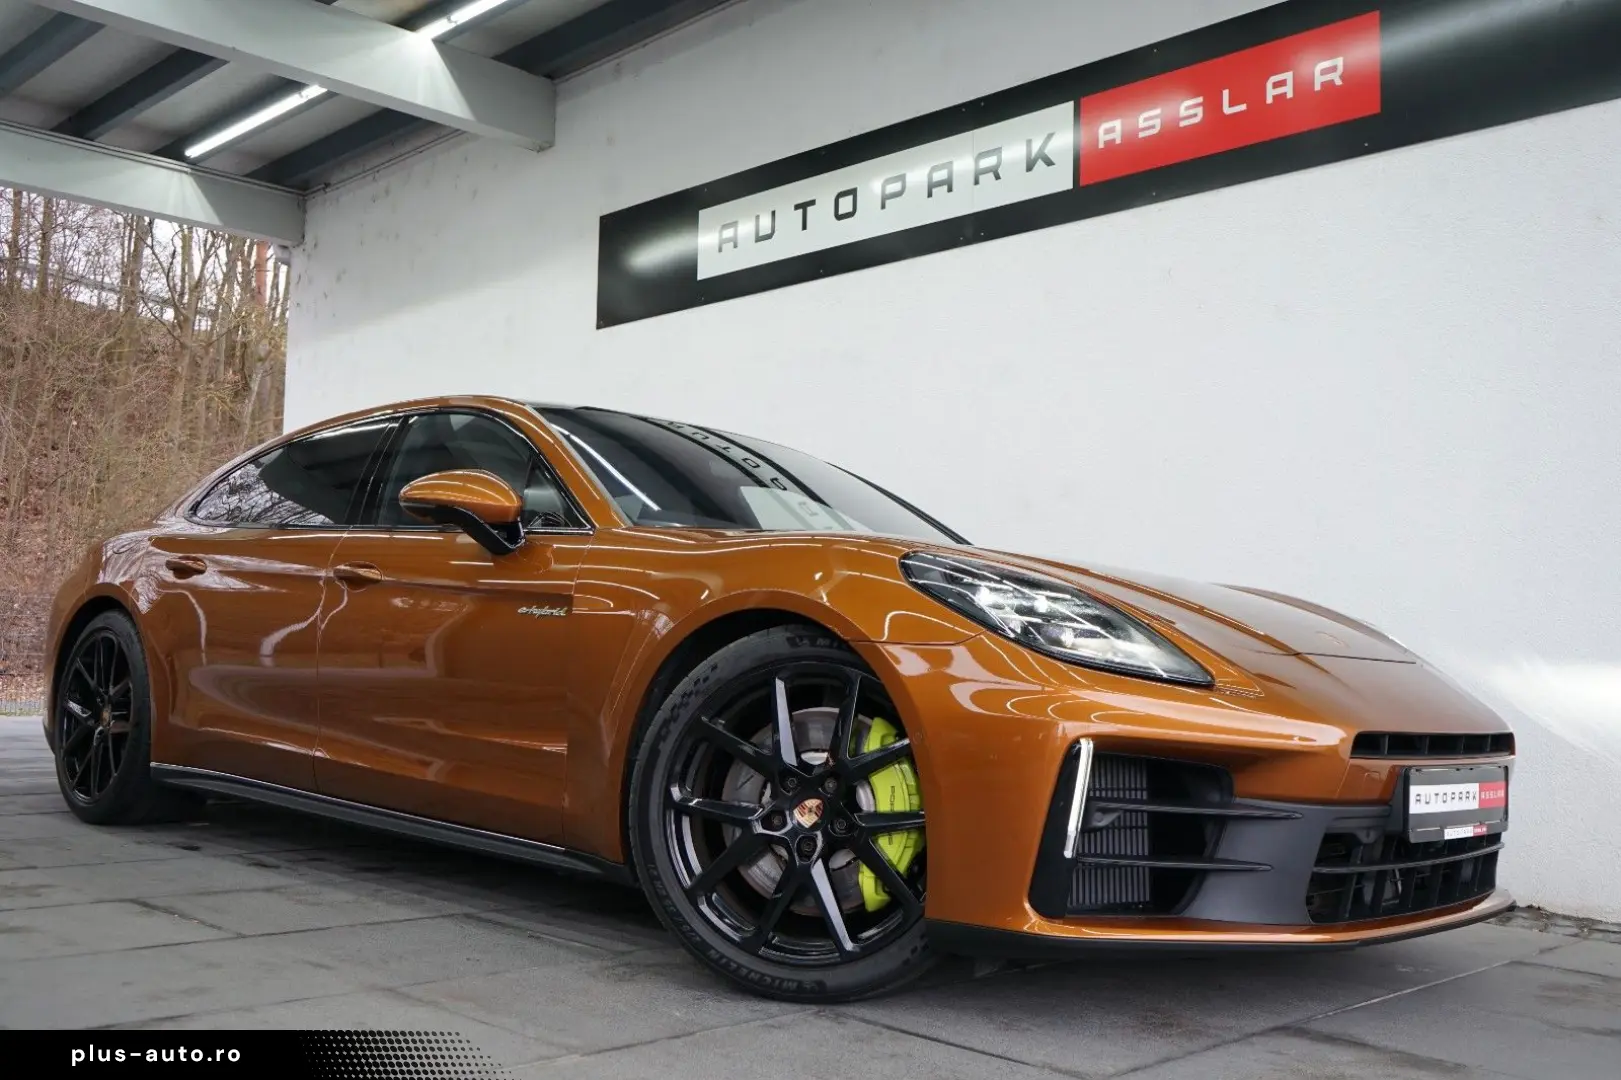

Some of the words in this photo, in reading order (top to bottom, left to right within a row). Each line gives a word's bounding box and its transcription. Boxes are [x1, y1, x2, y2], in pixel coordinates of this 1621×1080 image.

[718, 132, 1057, 253] AUTOPARK
[1097, 56, 1344, 149] ASSLAR
[1415, 791, 1477, 805] AUTOPARK
